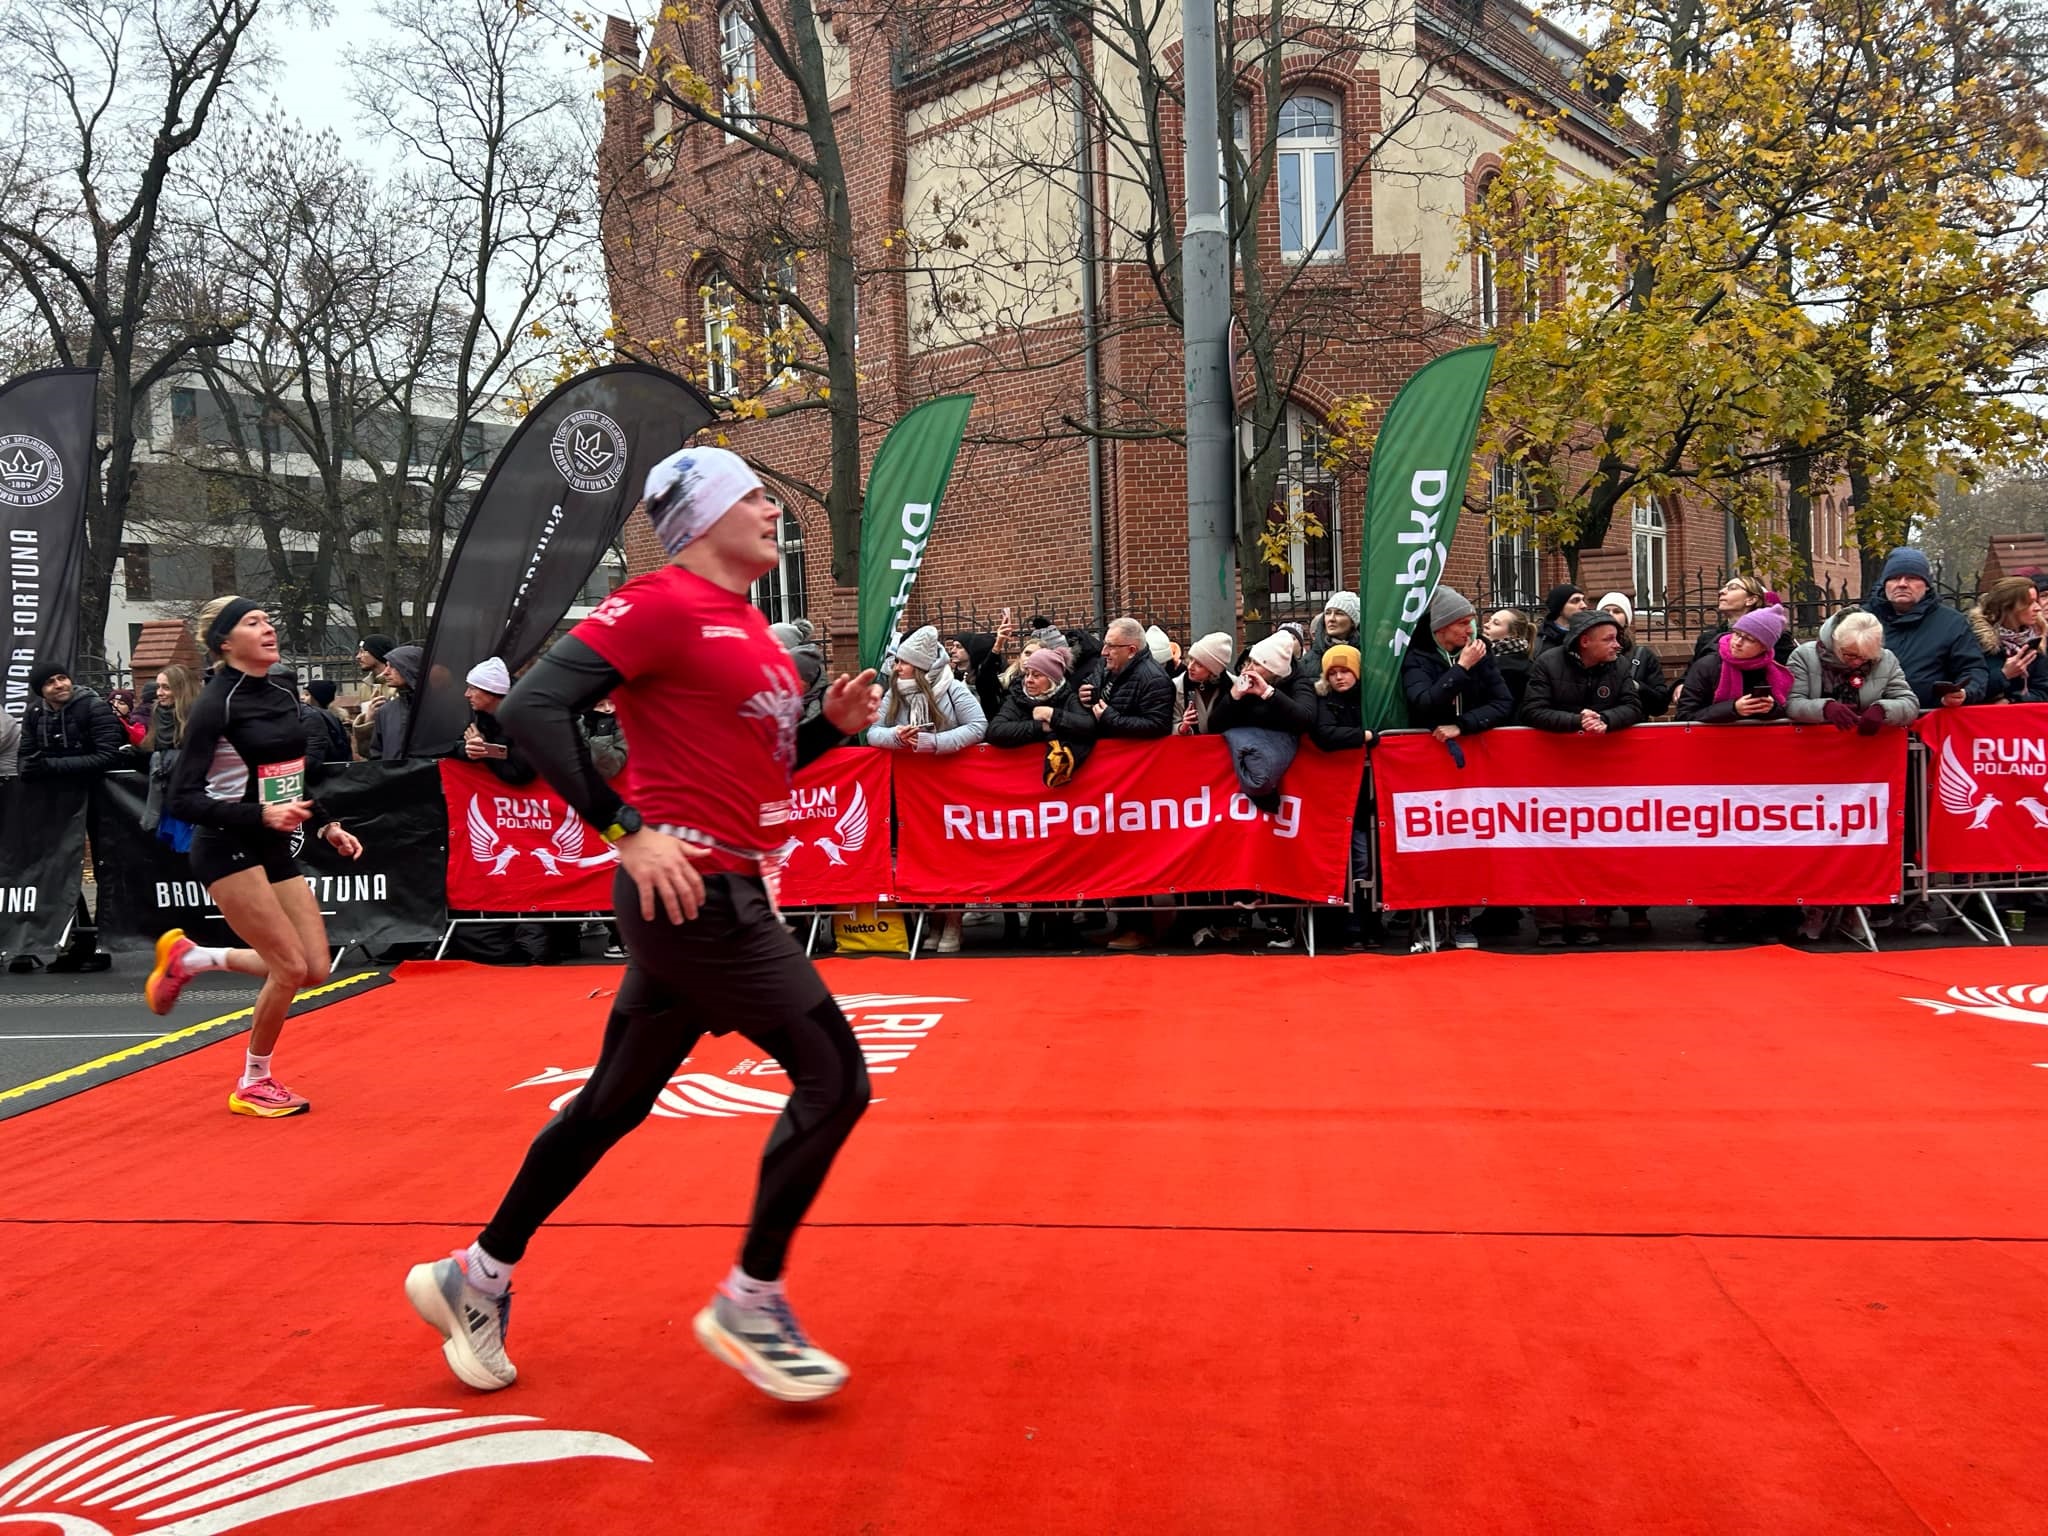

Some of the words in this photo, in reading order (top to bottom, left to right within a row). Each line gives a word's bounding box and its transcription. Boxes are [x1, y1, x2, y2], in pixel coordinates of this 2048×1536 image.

[10, 529, 40, 637] FORTUNA
[4, 648, 36, 728] OWAR
[1973, 737, 2047, 762] RUN
[1973, 762, 2048, 776] POLAND
[275, 775, 302, 795] 321
[493, 797, 550, 818] RUN
[788, 806, 838, 821] OLAND
[943, 785, 1303, 840] RunPoland.og
[1405, 795, 1879, 841] BiegNiepodleglosci.pl
[496, 817, 552, 830] POLAND
[842, 923, 876, 934] Netto
